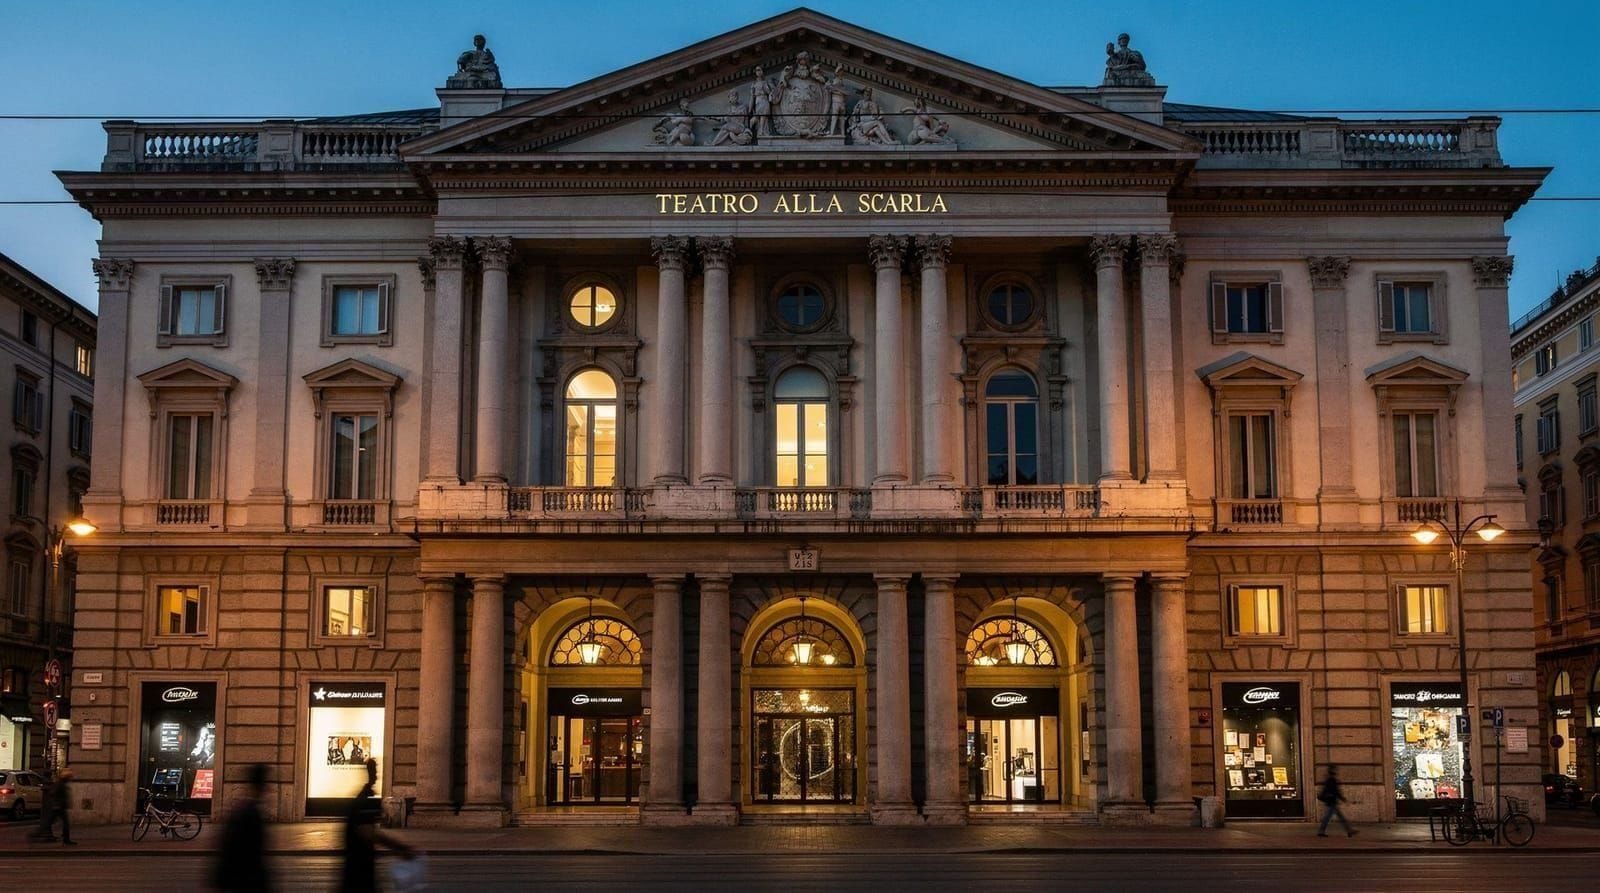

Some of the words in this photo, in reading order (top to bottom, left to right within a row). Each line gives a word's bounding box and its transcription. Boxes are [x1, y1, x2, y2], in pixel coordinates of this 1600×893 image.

[656, 194, 758, 213] TEATRO
[773, 194, 843, 213] ALLA
[858, 194, 948, 213] SCARLA
[1495, 710, 1502, 725] P
[1460, 718, 1467, 733] P
